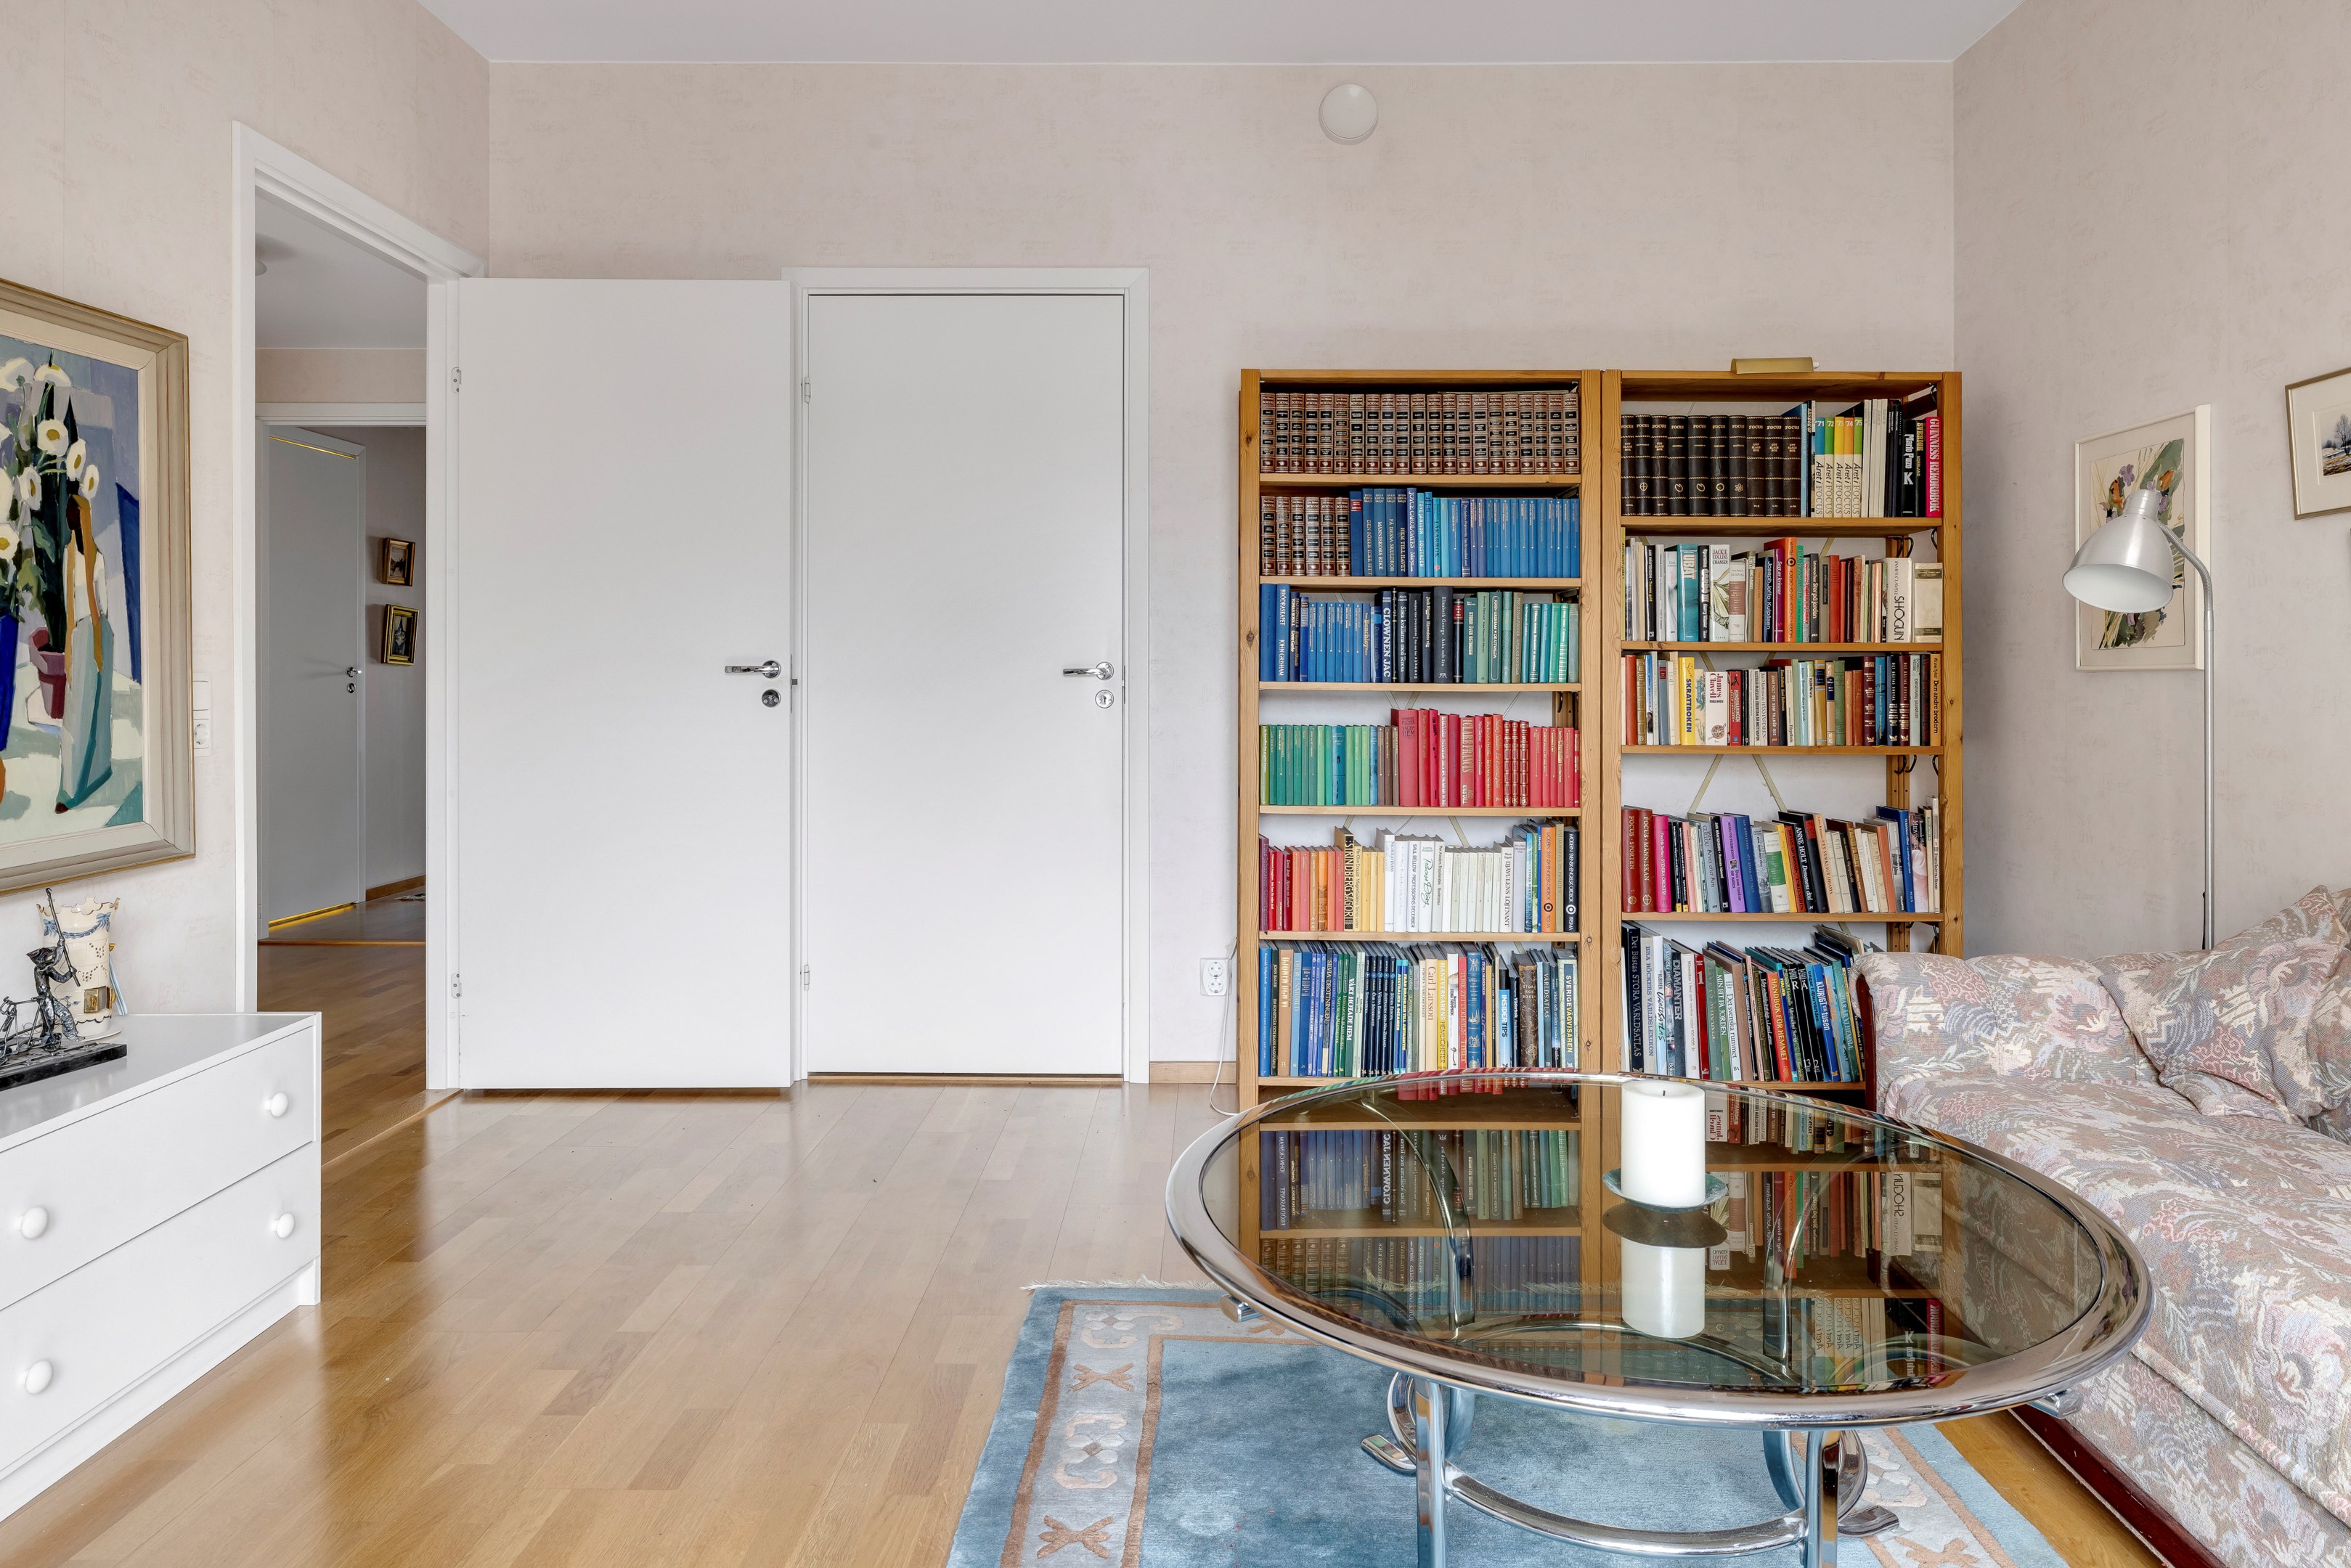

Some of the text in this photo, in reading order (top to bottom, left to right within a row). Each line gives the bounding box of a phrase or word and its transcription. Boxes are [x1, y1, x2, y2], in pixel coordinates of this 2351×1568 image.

[1904, 434, 1914, 452] Mario
[1904, 453, 1914, 468] Puzo
[1929, 418, 1939, 513] GUINNESS REKORDBOK
[1683, 554, 1697, 579] UBÅT
[1631, 951, 1641, 972] Bästas
[1427, 966, 1436, 1020] Carl Larsson
[1673, 960, 1682, 1020] DIAMANTER
[1816, 981, 1830, 1030] KLURIGT tusen
[1634, 1003, 1642, 1056] VÄRLDSATLAS
[1772, 979, 1780, 1013] HANDBOK
[1777, 1030, 1787, 1061] HEMMET
